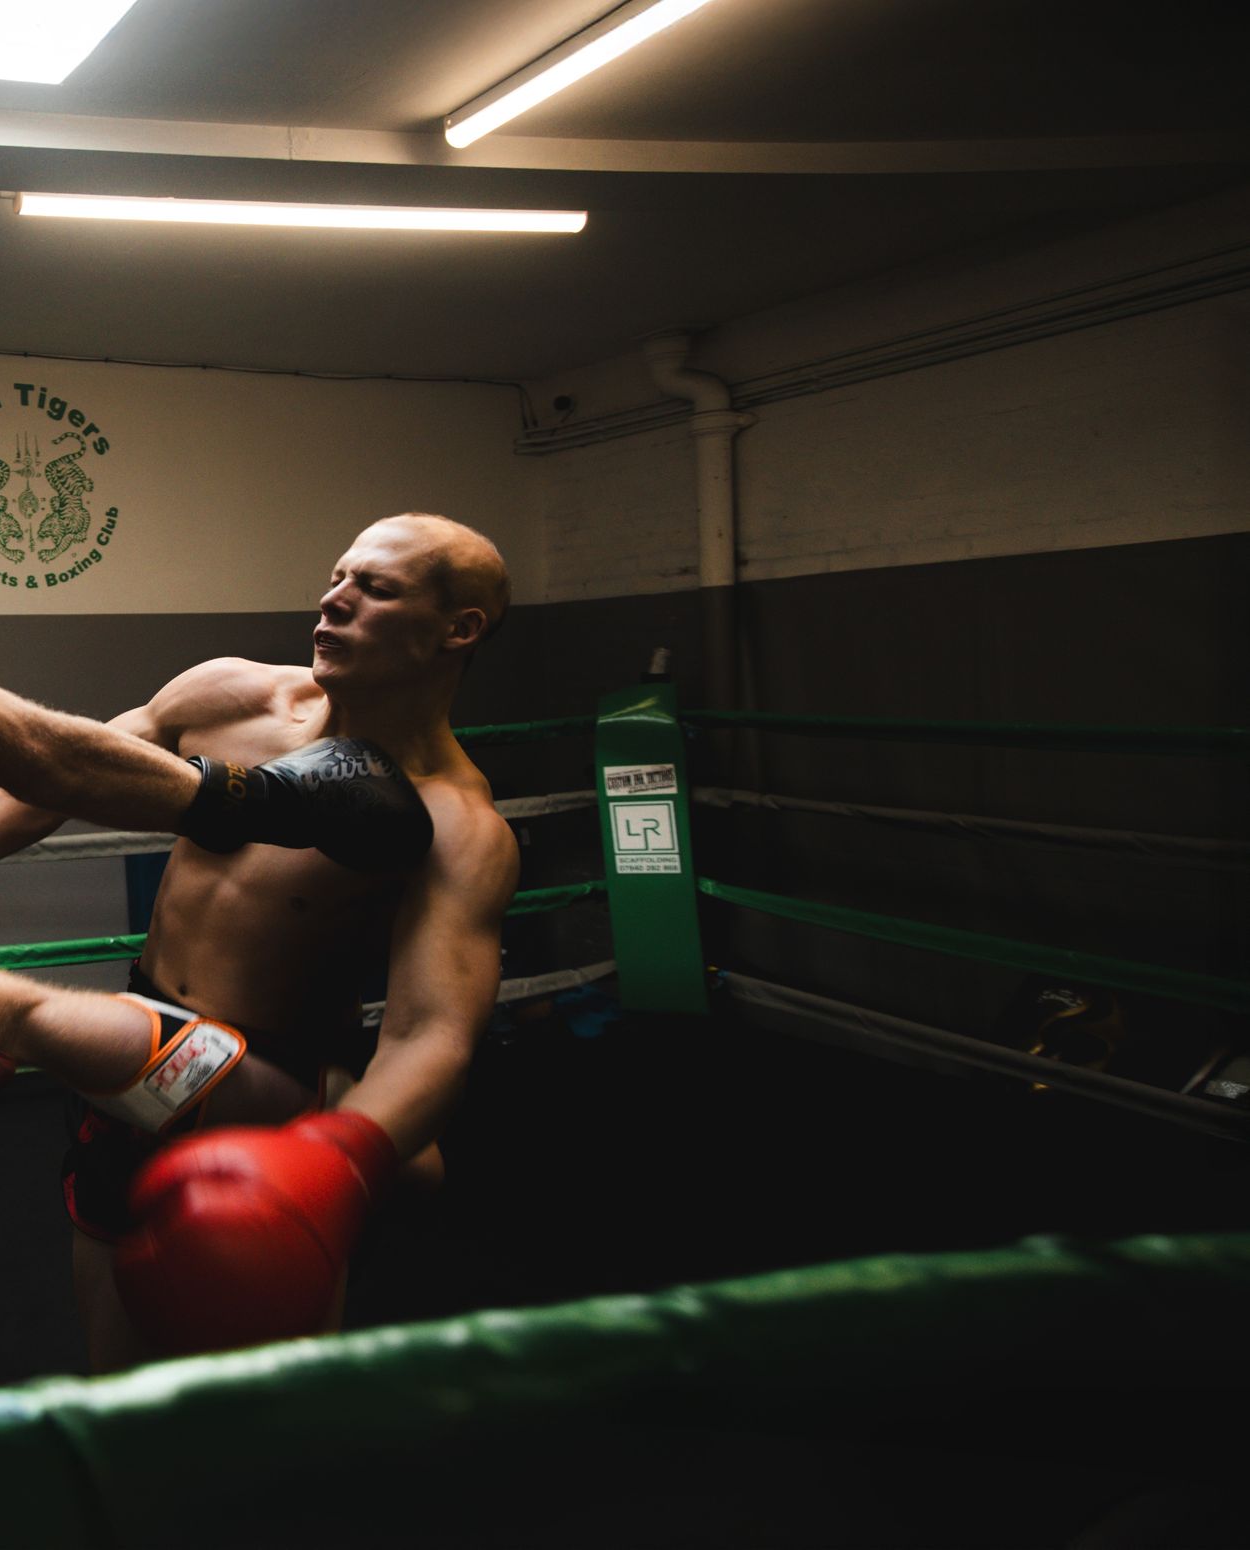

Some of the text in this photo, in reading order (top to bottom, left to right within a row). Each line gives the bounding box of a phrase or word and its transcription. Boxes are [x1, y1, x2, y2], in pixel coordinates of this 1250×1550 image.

[13, 382, 111, 456] Tigers
[25, 575, 39, 589] &
[45, 548, 104, 587] Boxing
[97, 506, 119, 547] Club
